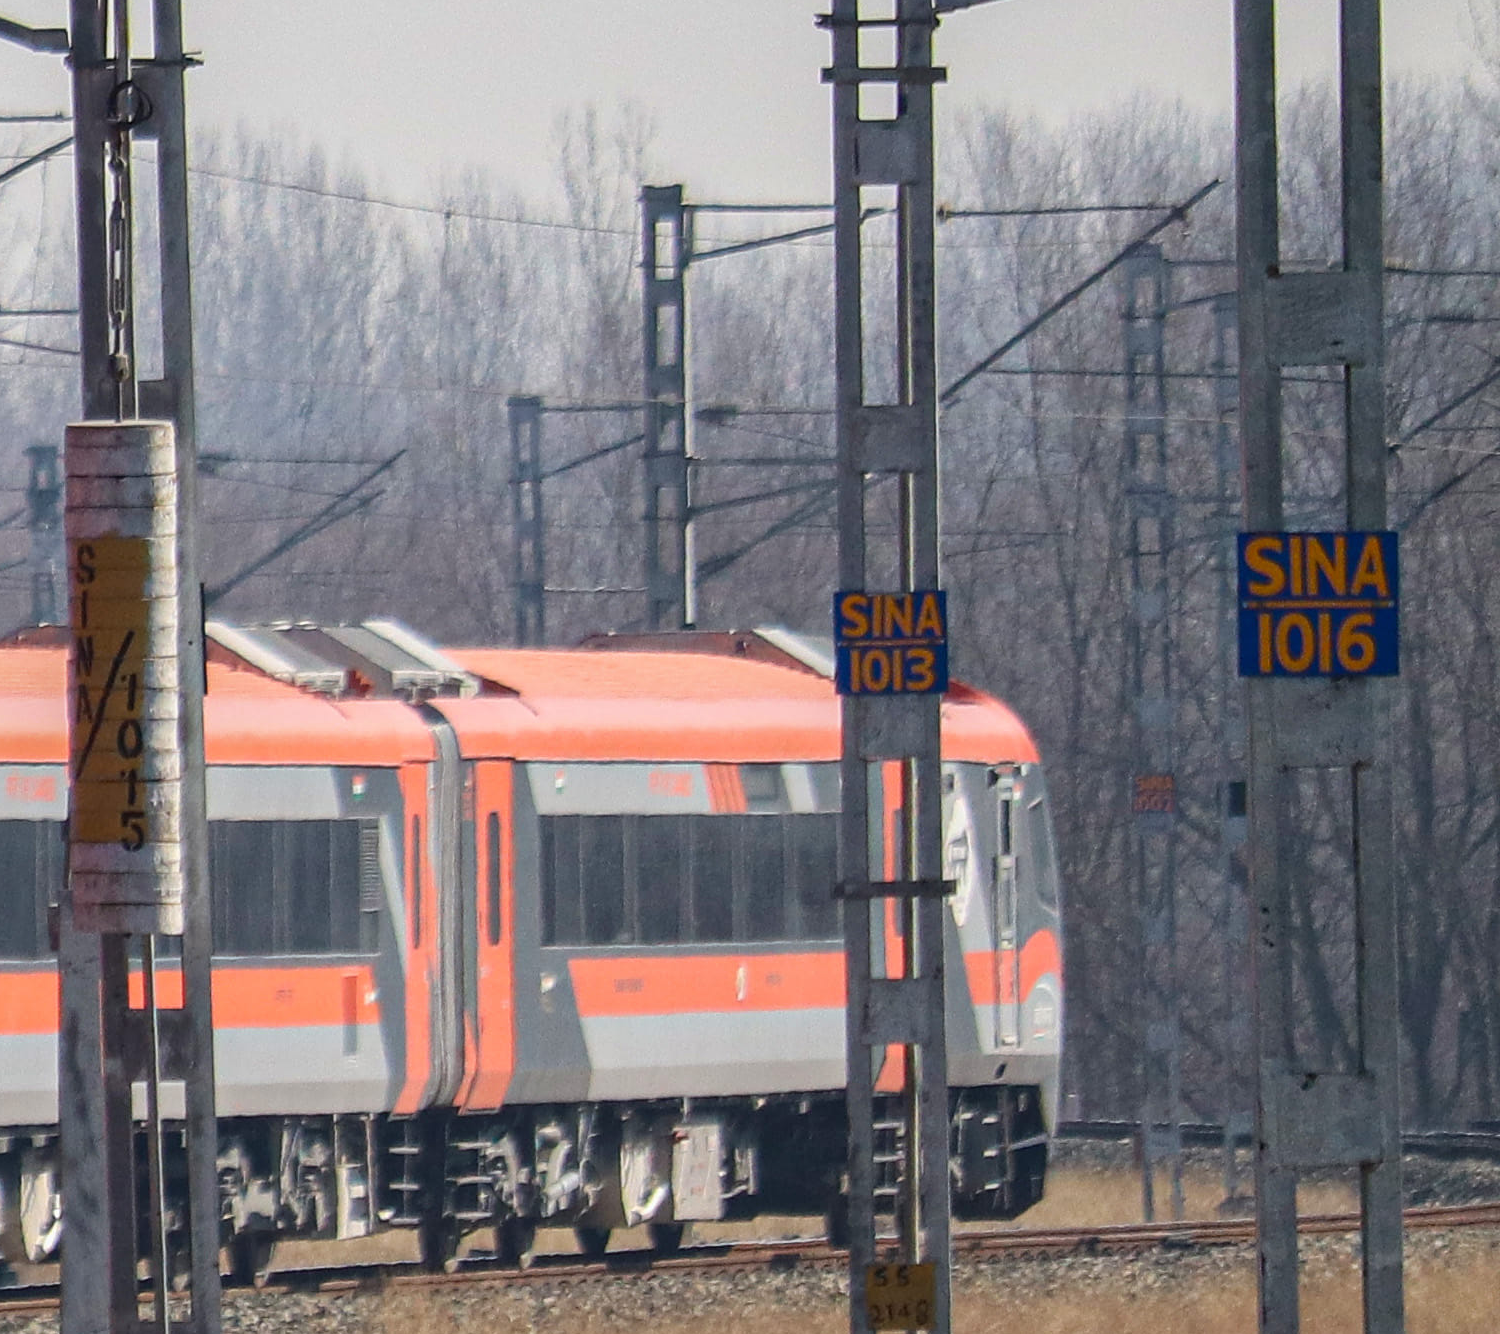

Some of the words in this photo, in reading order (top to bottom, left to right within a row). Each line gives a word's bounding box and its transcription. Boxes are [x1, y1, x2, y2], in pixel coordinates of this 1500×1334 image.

[1244, 536, 1390, 597] SINA
[840, 592, 944, 638] SINA
[1257, 612, 1377, 674] 1016
[76, 543, 96, 725] SINA
[117, 673, 145, 852] 1015
[850, 648, 937, 693] 1013
